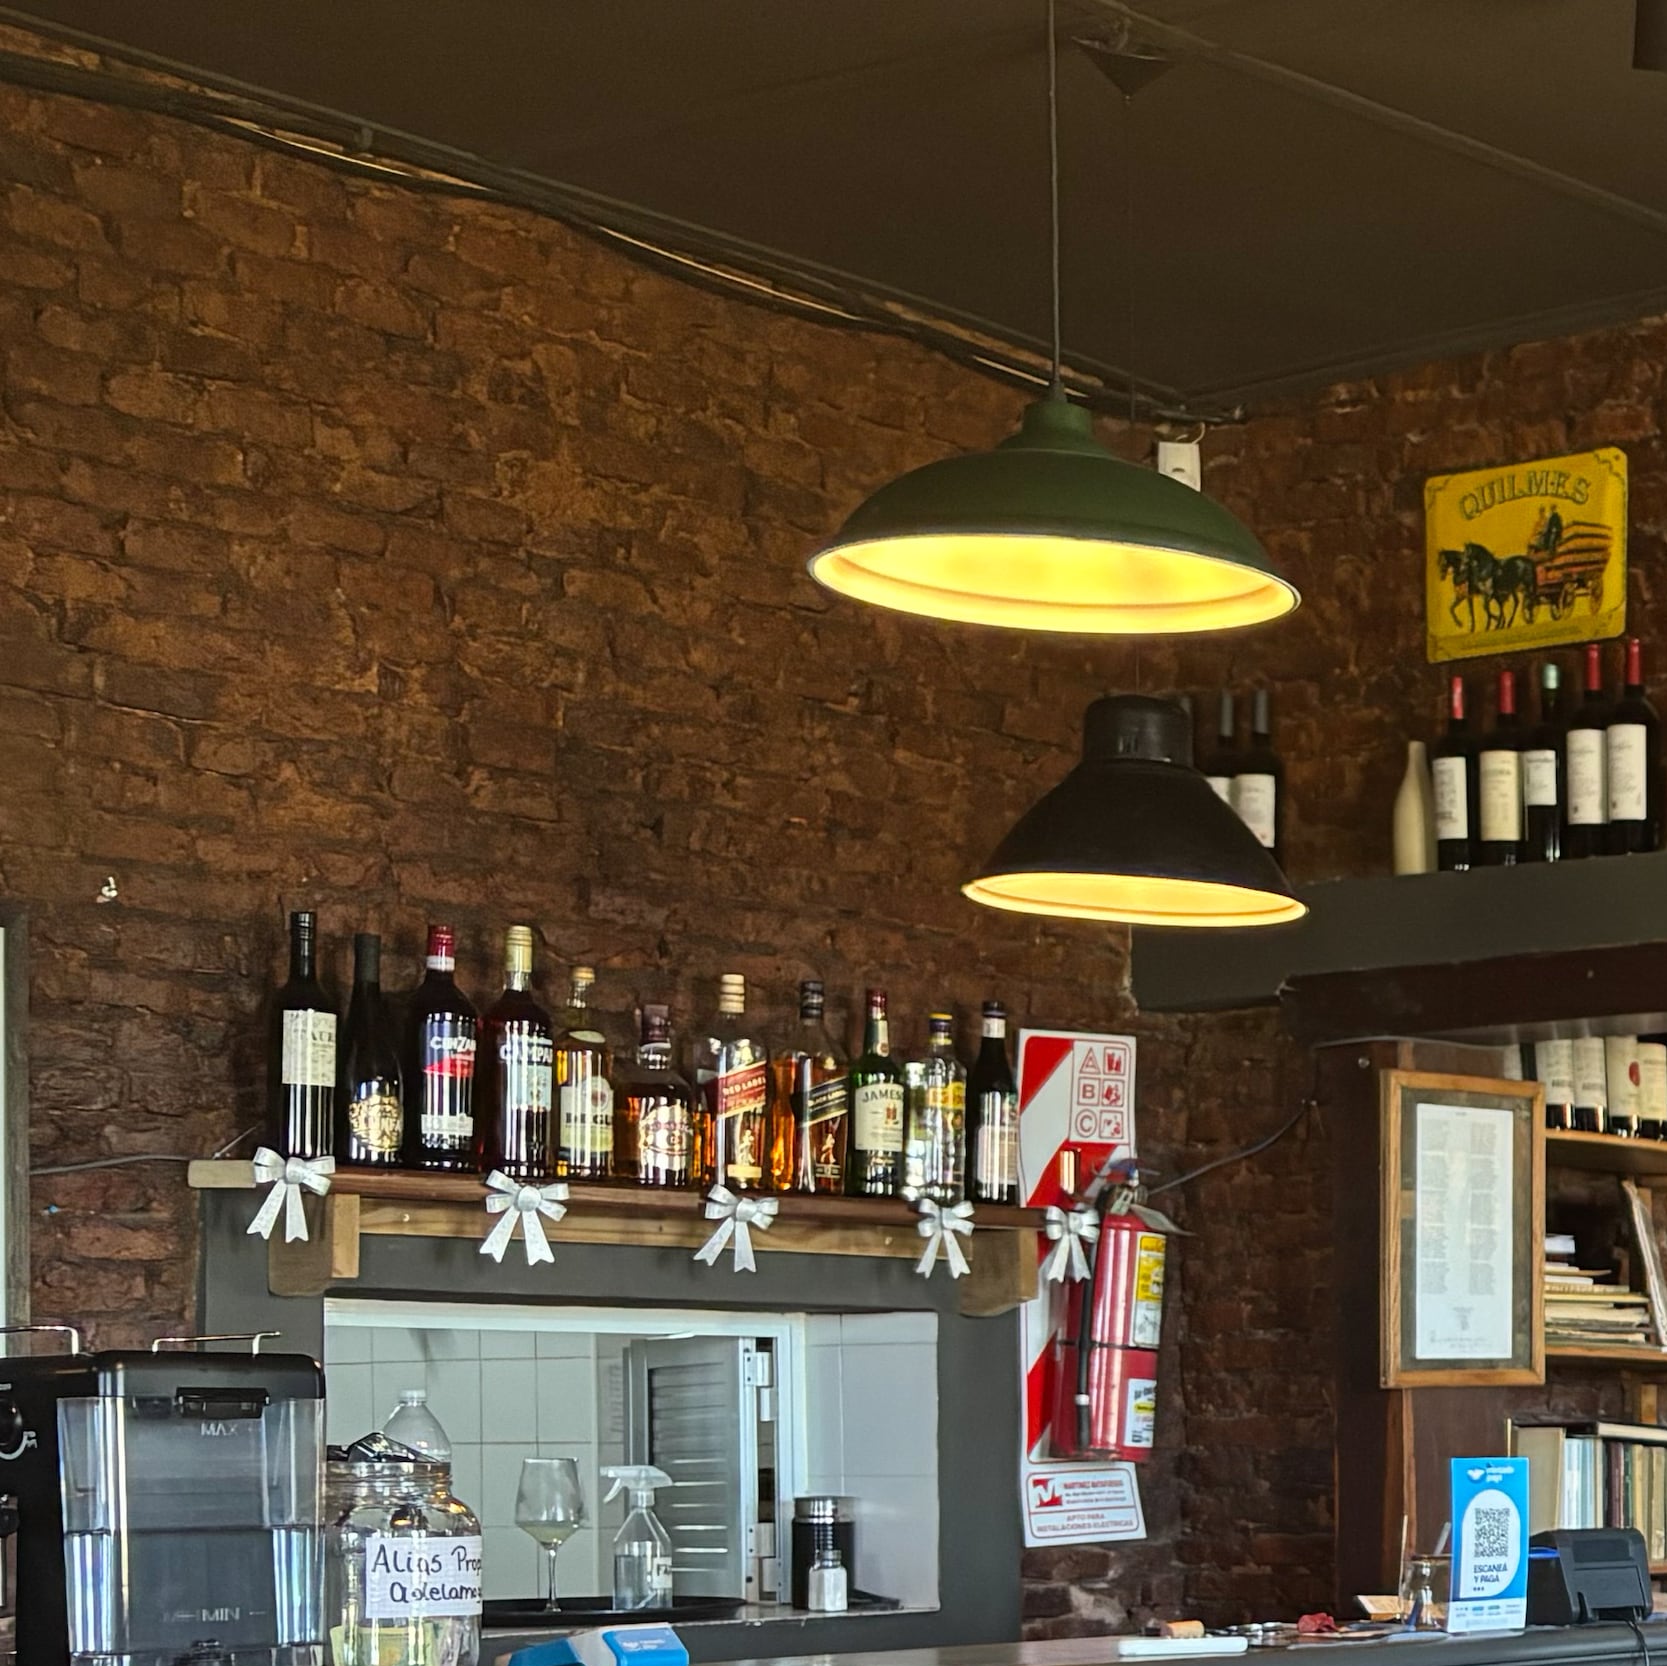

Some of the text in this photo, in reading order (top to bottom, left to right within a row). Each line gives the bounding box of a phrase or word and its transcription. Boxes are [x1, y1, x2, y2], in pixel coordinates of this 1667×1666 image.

[1459, 470, 1592, 521] QUILMES
[1084, 1056, 1096, 1069] A
[1082, 1084, 1096, 1099] B
[1079, 1115, 1093, 1133] C
[201, 1422, 238, 1437] MAX
[371, 1543, 443, 1576] Alias
[201, 1607, 240, 1622] MIN
